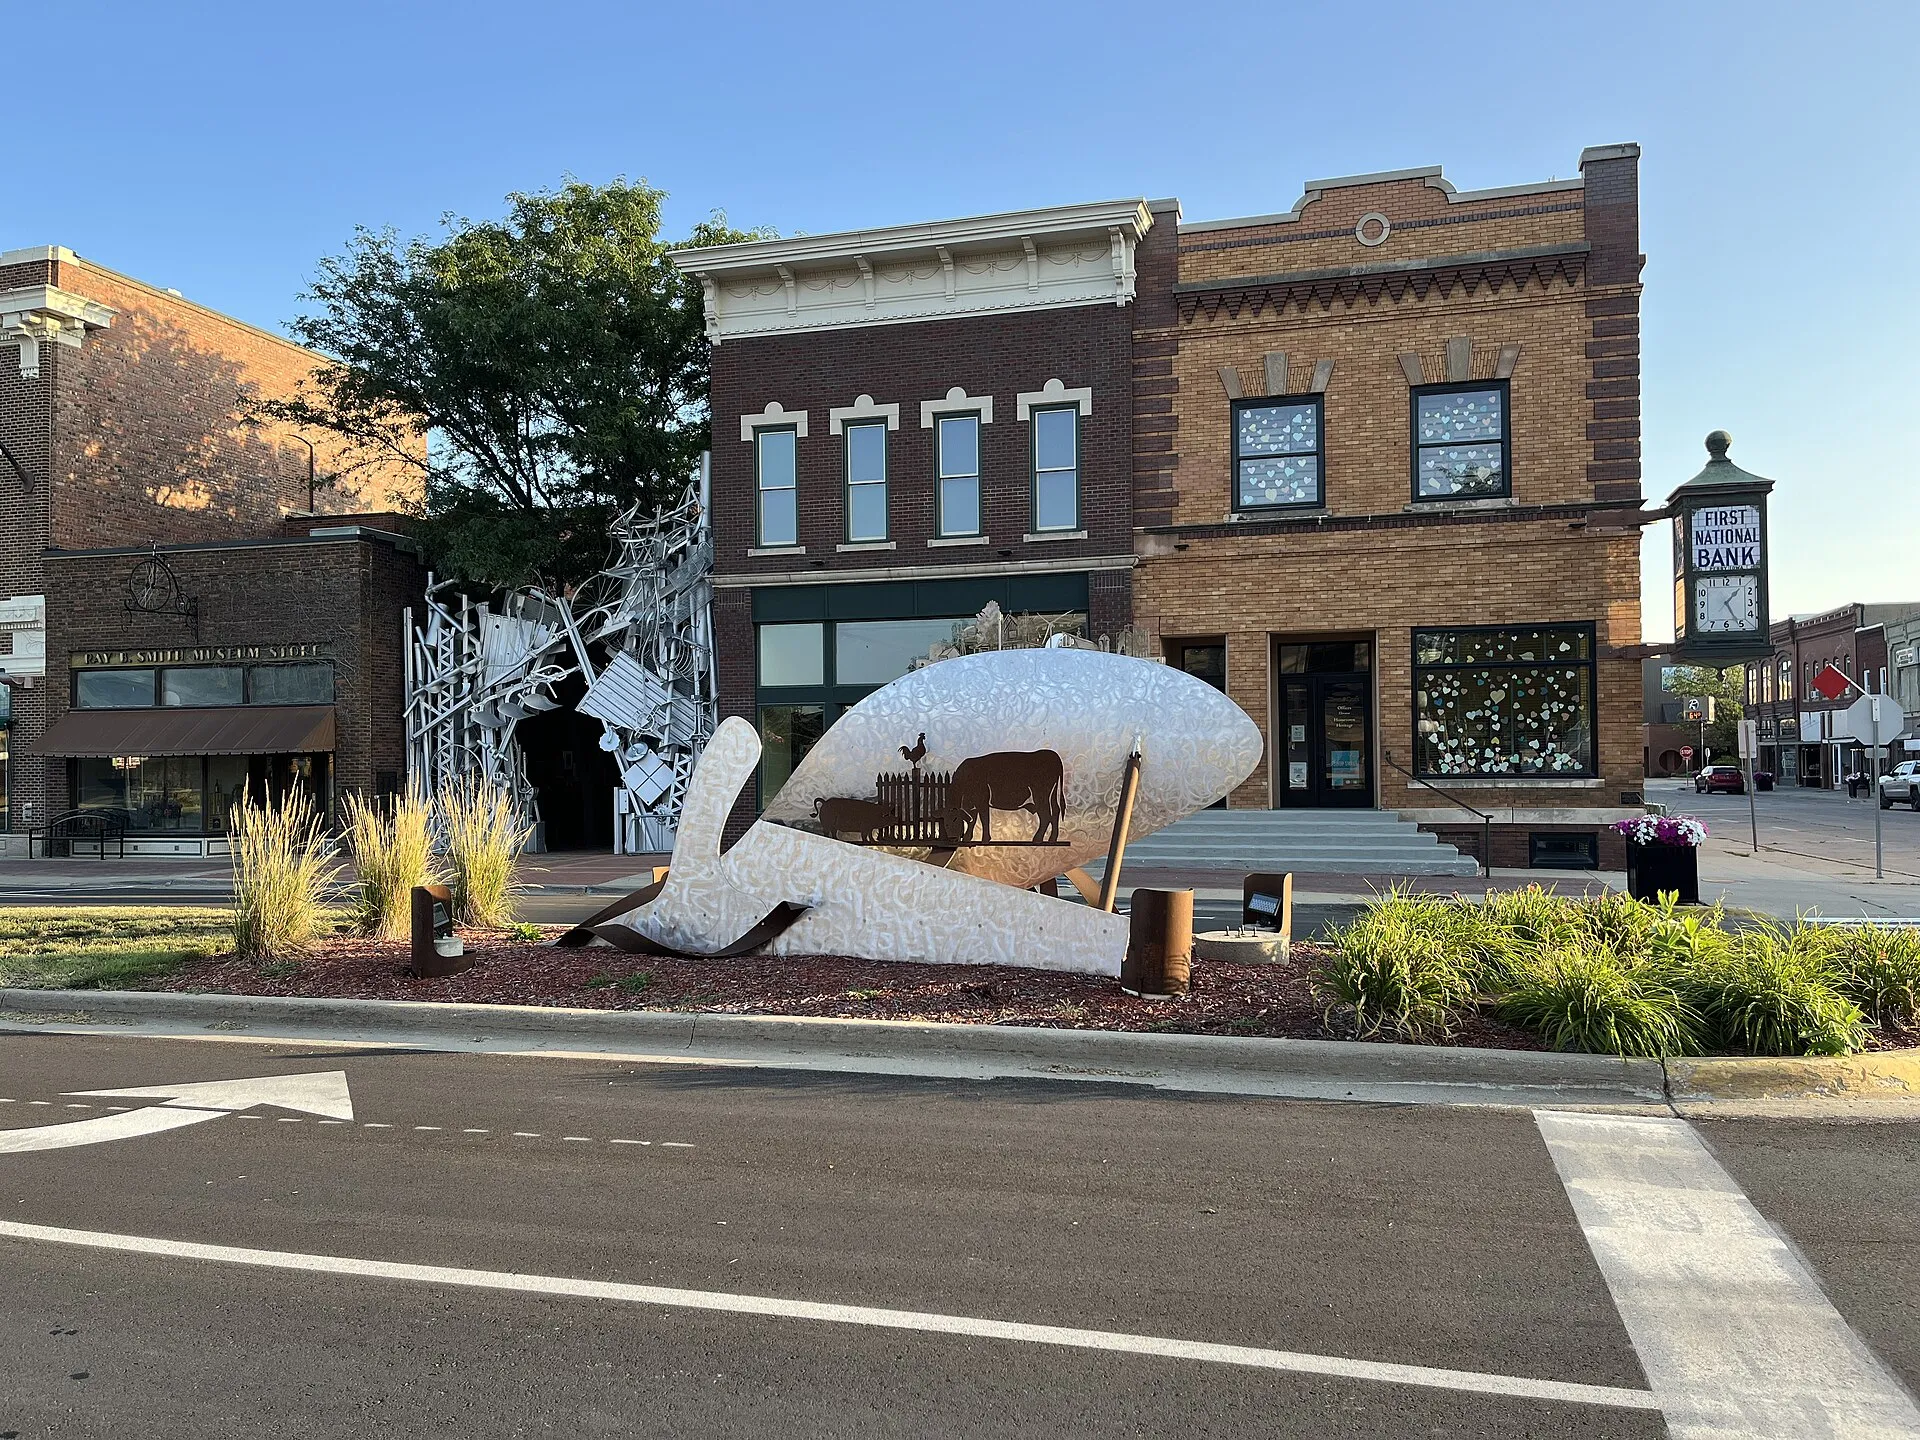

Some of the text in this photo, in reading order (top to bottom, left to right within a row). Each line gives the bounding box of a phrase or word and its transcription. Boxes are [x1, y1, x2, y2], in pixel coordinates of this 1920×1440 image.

[1705, 509, 1747, 526] FIRST
[1695, 527, 1760, 546] NATIONAL
[1698, 546, 1755, 568] BANK
[1709, 579, 1716, 587] 11
[1722, 578, 1730, 587] 12
[1698, 589, 1706, 598] 10
[1747, 587, 1753, 596] 2
[1699, 600, 1706, 609] 9
[1747, 598, 1754, 607] 3
[1699, 612, 1706, 620] 8
[1747, 610, 1754, 619] 4
[1709, 620, 1716, 629] 7
[1723, 620, 1730, 629] 6
[1738, 619, 1745, 628] 5
[84, 643, 320, 665] RAY B. SMITH MUSEUM STORE
